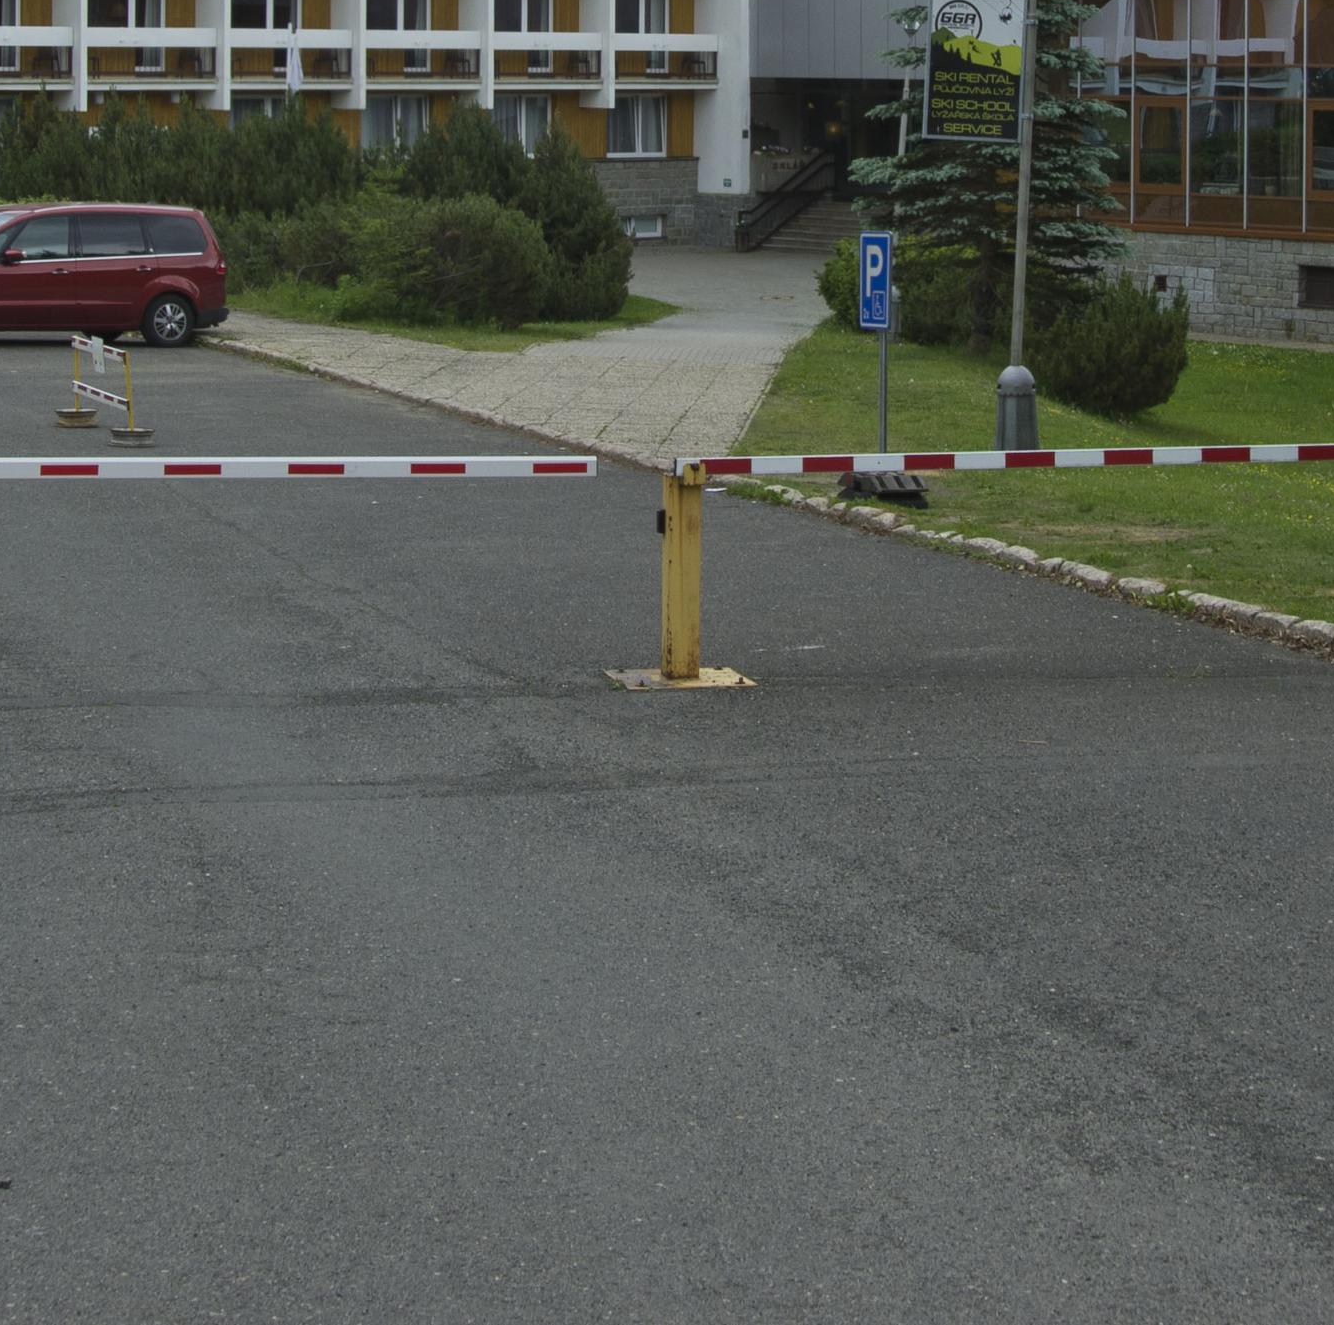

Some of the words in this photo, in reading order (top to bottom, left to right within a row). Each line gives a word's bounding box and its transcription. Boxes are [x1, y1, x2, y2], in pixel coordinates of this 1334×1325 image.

[934, 71, 957, 82] SKI
[959, 72, 1015, 85] RENTAL
[931, 98, 954, 108] SKI
[956, 99, 1016, 112] SCHOOL
[943, 122, 1003, 135] SERVICE
[866, 244, 884, 297] P
